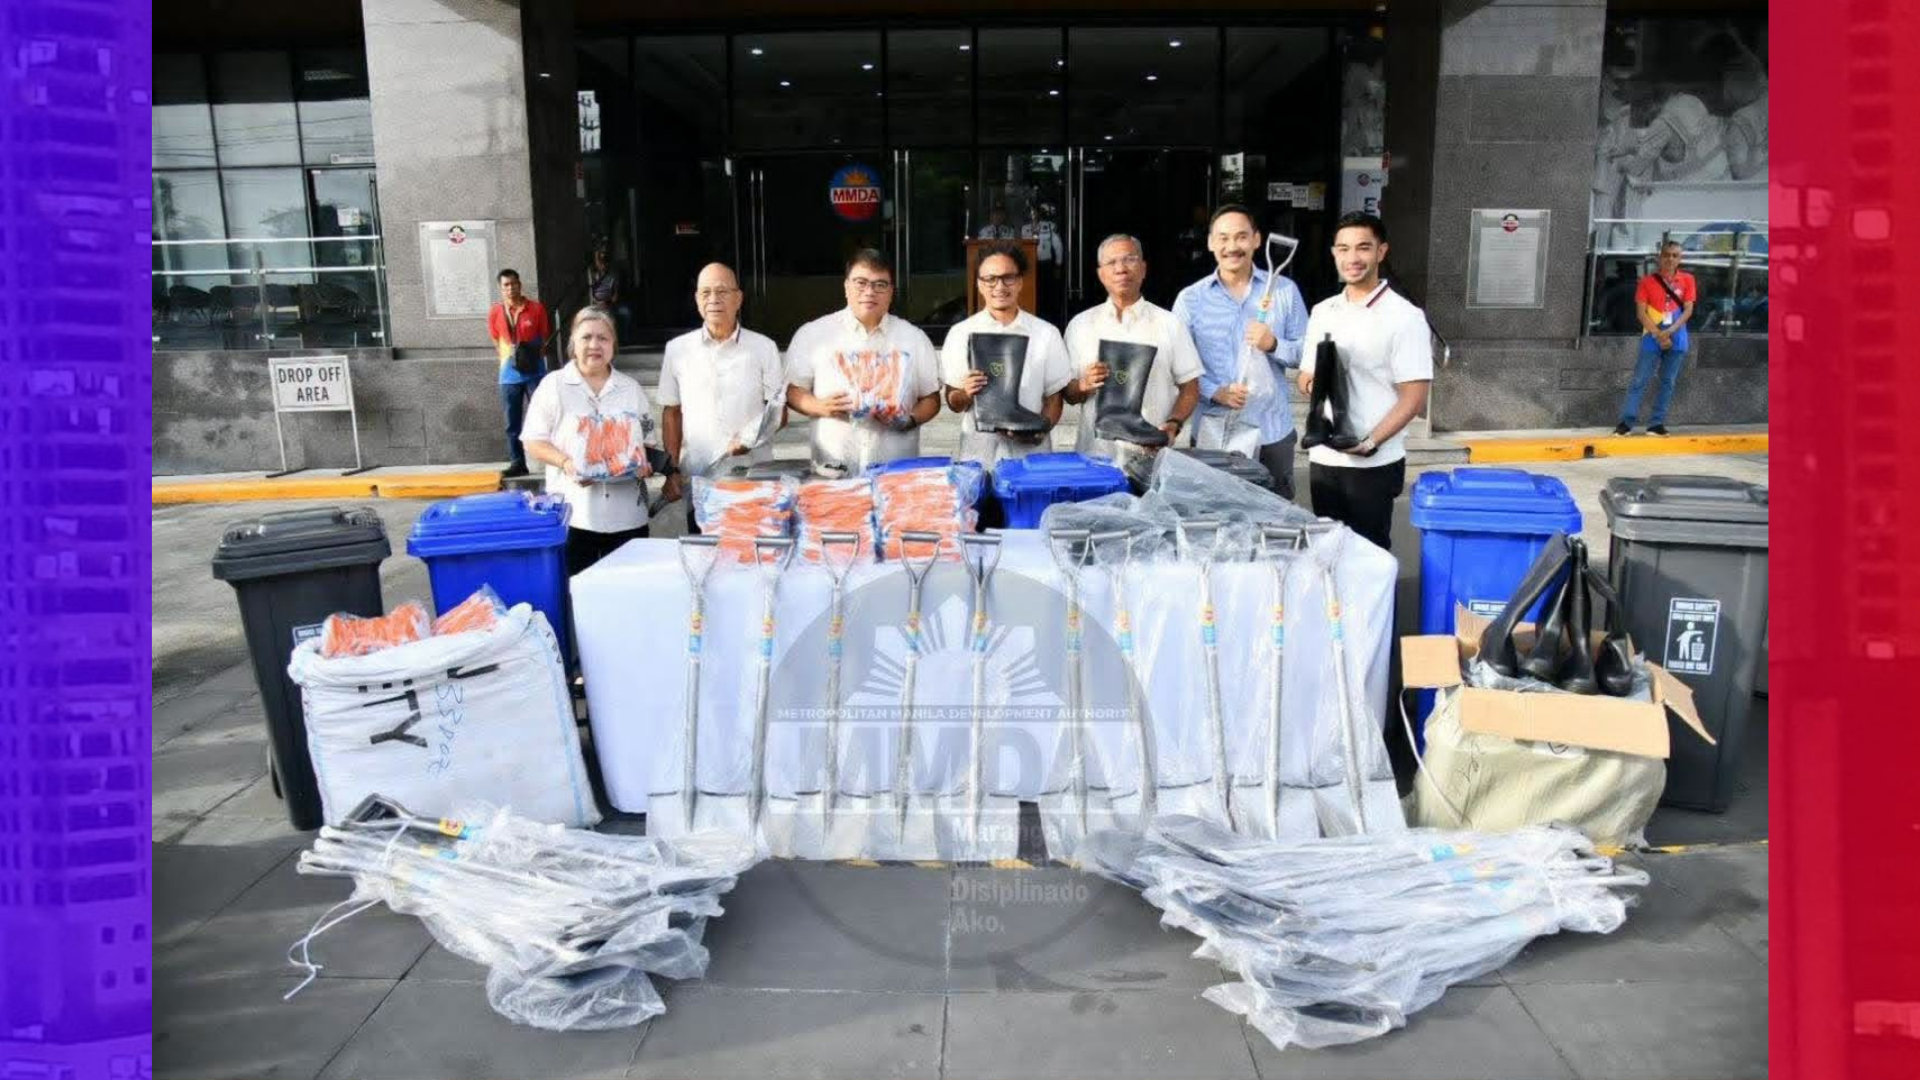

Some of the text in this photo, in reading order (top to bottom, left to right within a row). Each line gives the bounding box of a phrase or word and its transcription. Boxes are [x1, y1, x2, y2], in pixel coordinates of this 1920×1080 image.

[833, 188, 879, 202] MMDA
[278, 366, 341, 383] DROP OFF
[297, 386, 330, 402] AREA
